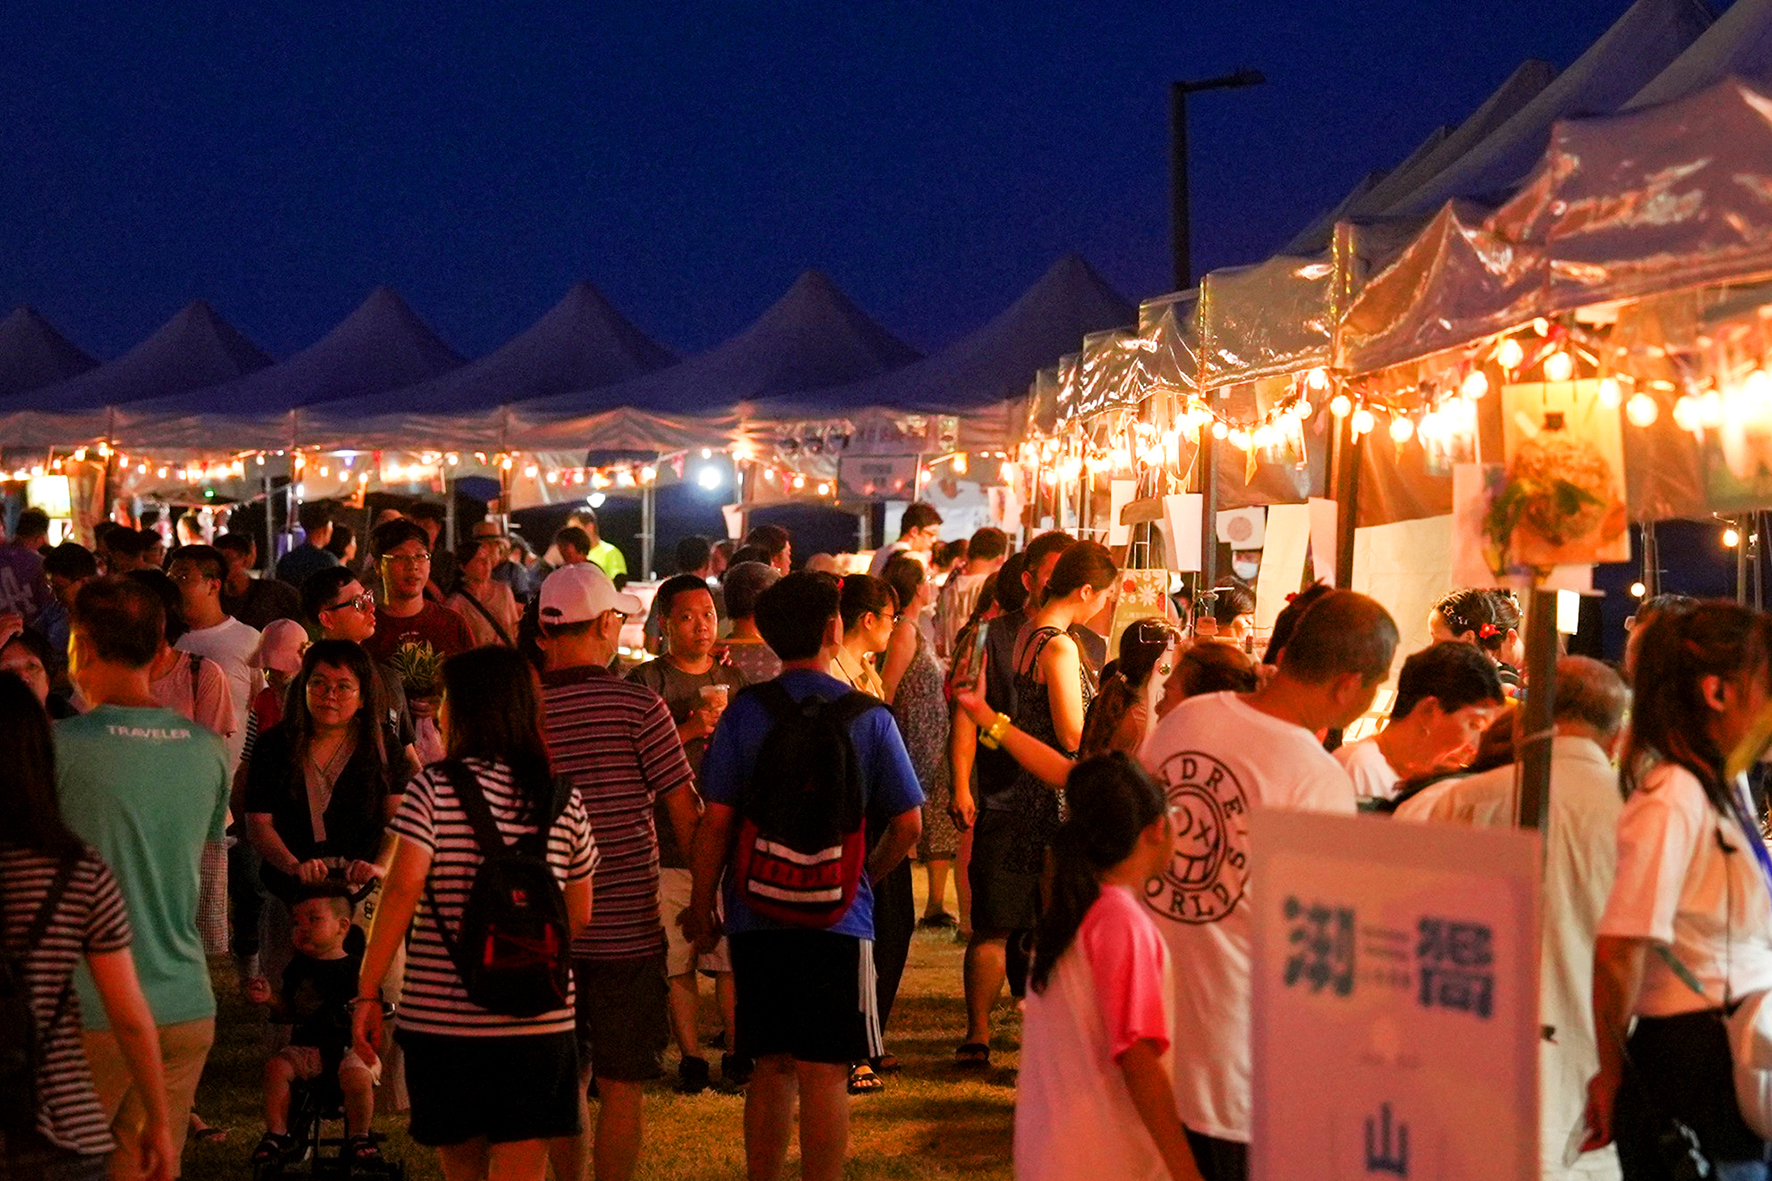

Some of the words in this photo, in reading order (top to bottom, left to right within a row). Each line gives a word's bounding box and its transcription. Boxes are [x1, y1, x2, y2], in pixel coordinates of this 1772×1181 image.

[106, 725, 192, 739] TRAVELER
[1145, 876, 1230, 917] ORLD
[1365, 1102, 1408, 1179] 山
